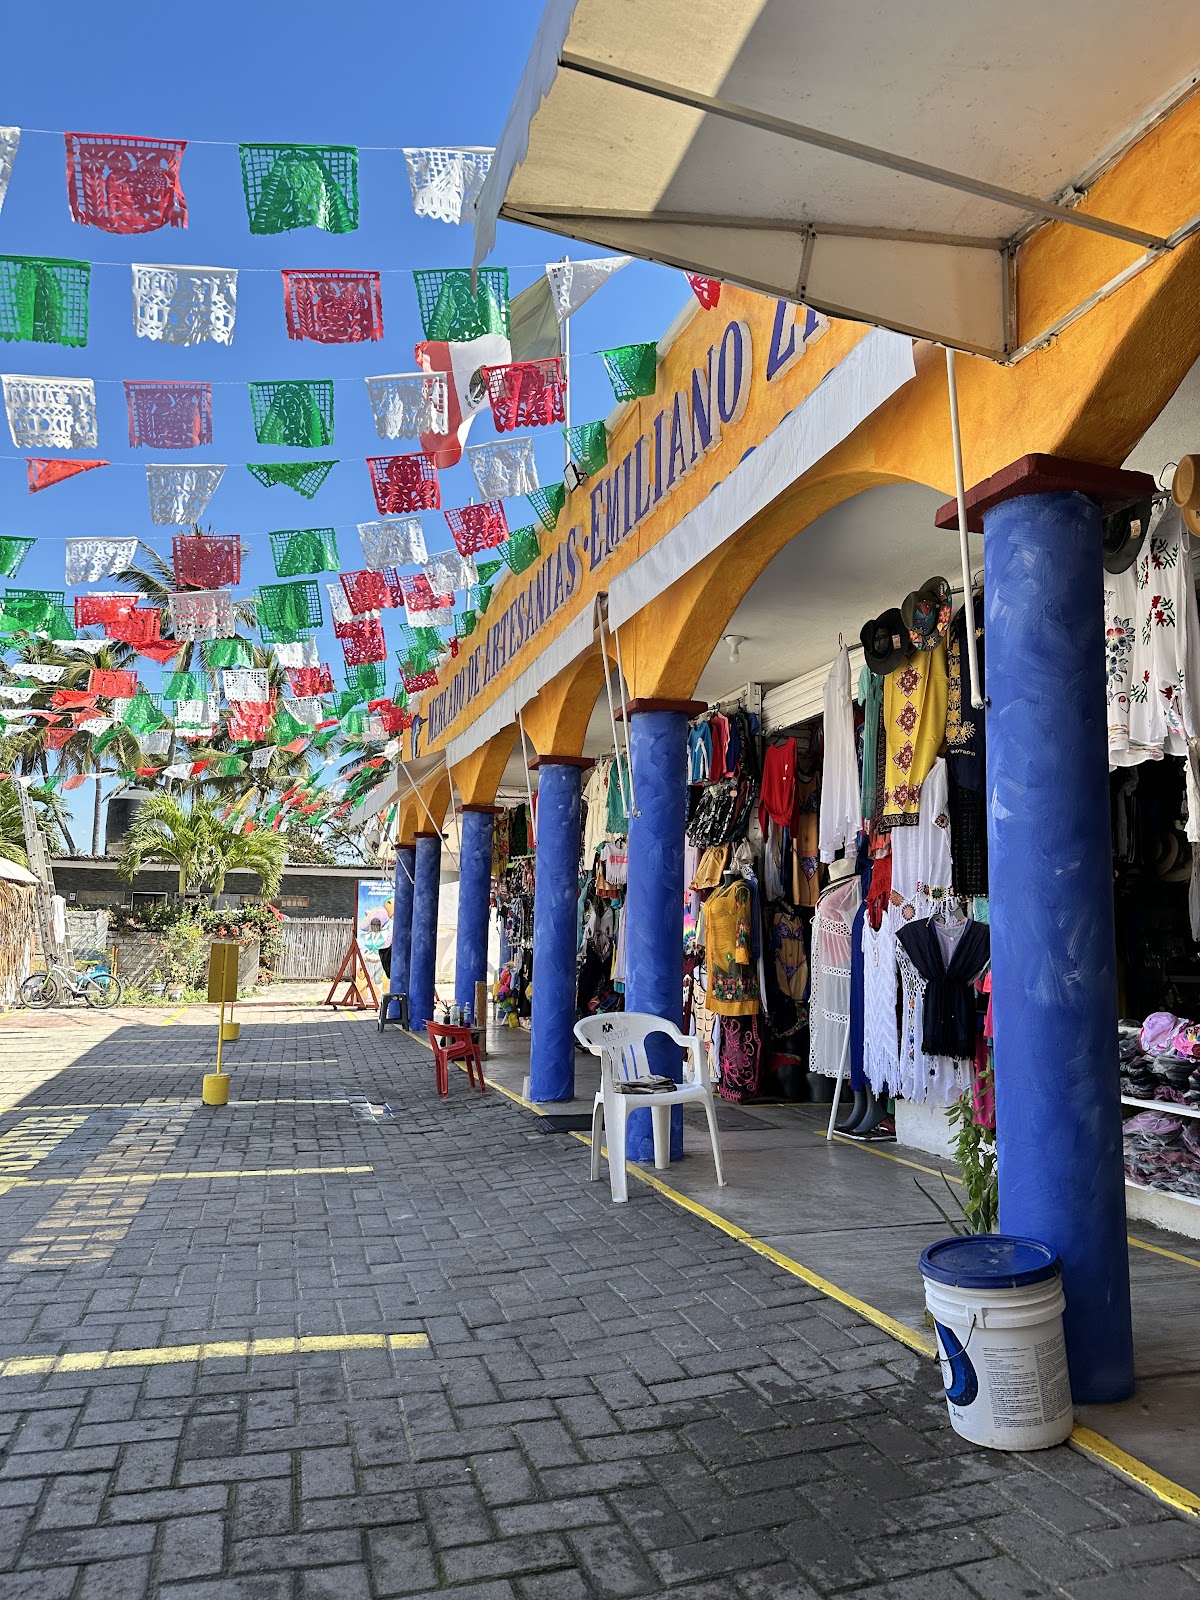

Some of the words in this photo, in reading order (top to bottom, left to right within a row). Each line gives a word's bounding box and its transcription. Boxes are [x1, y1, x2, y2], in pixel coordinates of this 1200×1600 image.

[428, 666, 467, 745] MERCADO
[467, 645, 484, 704] DE
[482, 526, 581, 687] ARTESANIAS
[590, 321, 752, 573] EMILIANO
